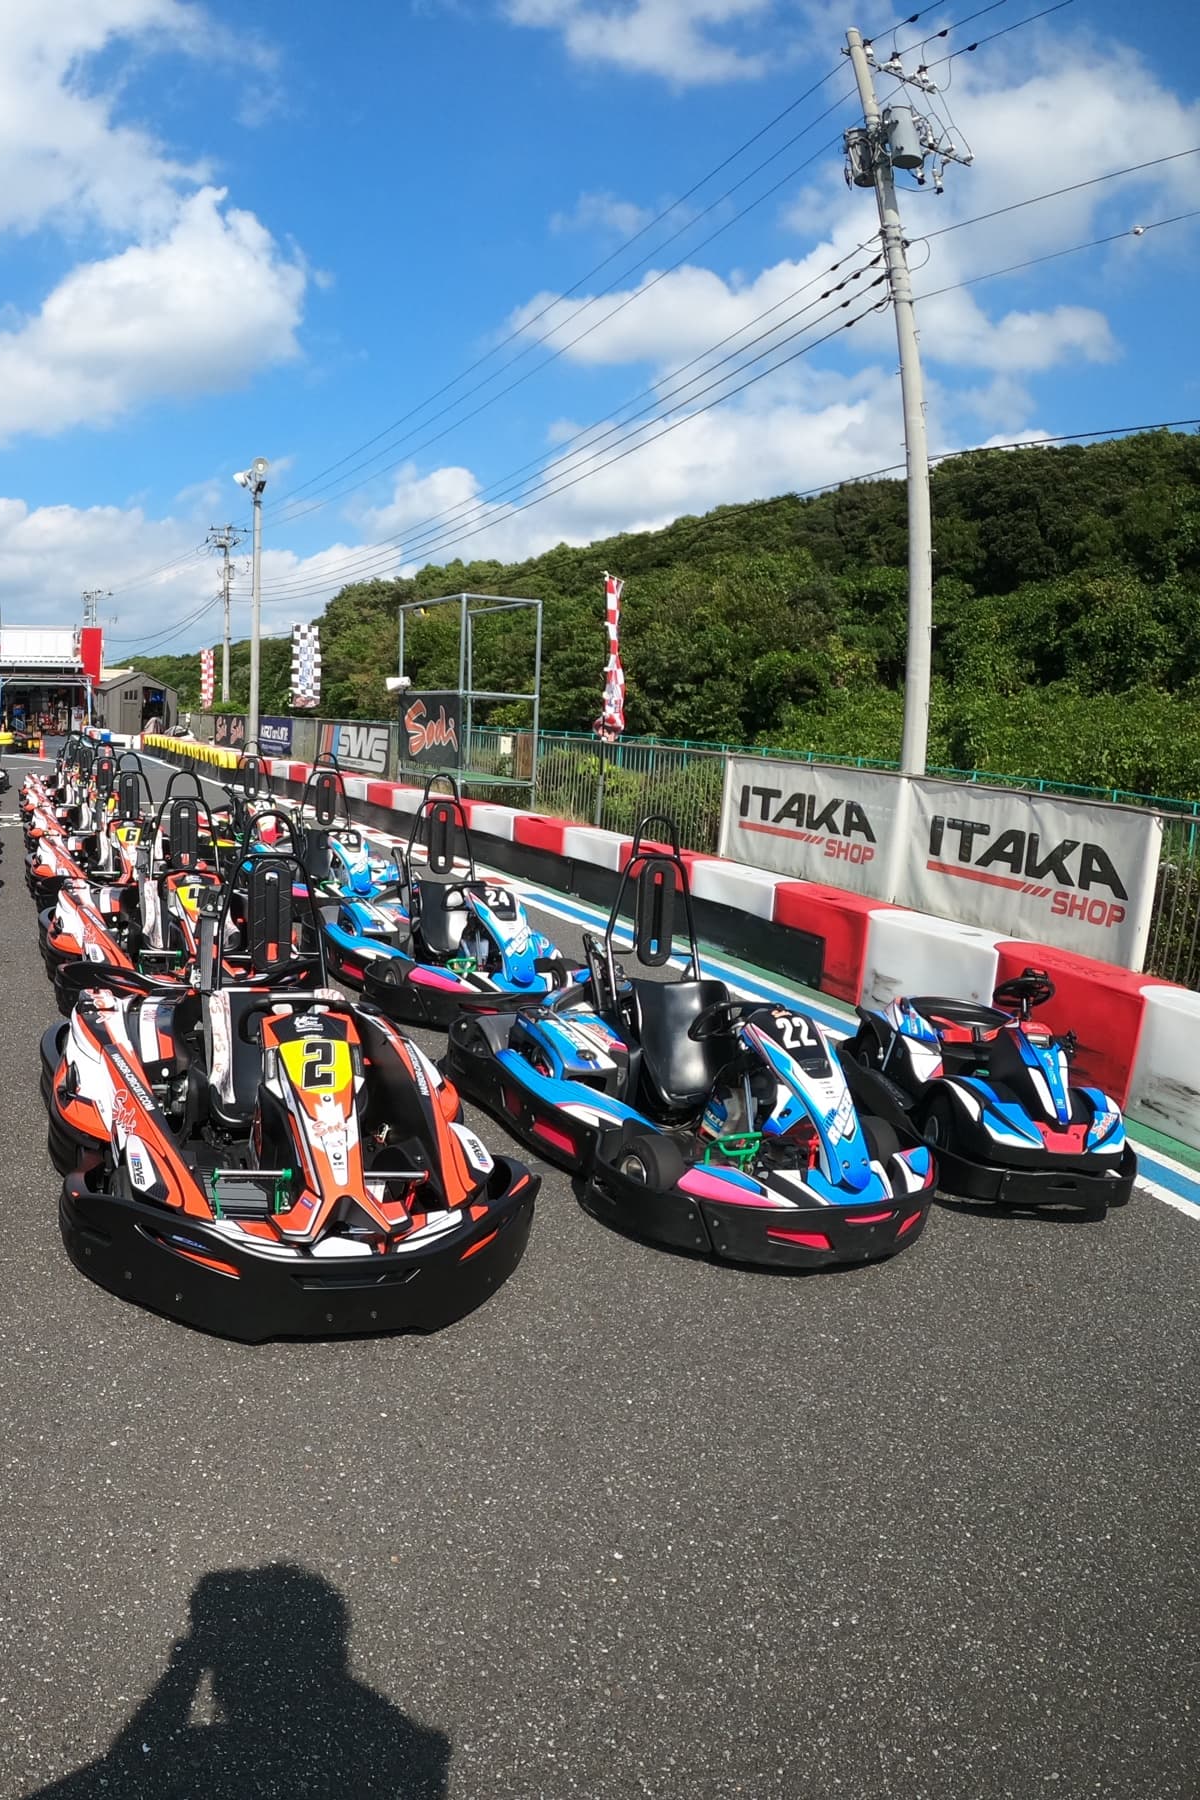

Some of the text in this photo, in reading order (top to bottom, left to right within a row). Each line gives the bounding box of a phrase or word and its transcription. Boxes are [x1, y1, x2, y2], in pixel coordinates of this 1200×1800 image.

[404, 699, 459, 757] Sodi
[739, 785, 877, 843] ITAKA
[125, 829, 138, 843] 6
[824, 838, 875, 865] SHOP
[929, 815, 1129, 901] ITAKA
[485, 889, 510, 907] 24
[1051, 890, 1126, 928] SHOP
[775, 1017, 818, 1049] 22
[302, 1039, 335, 1090] 2
